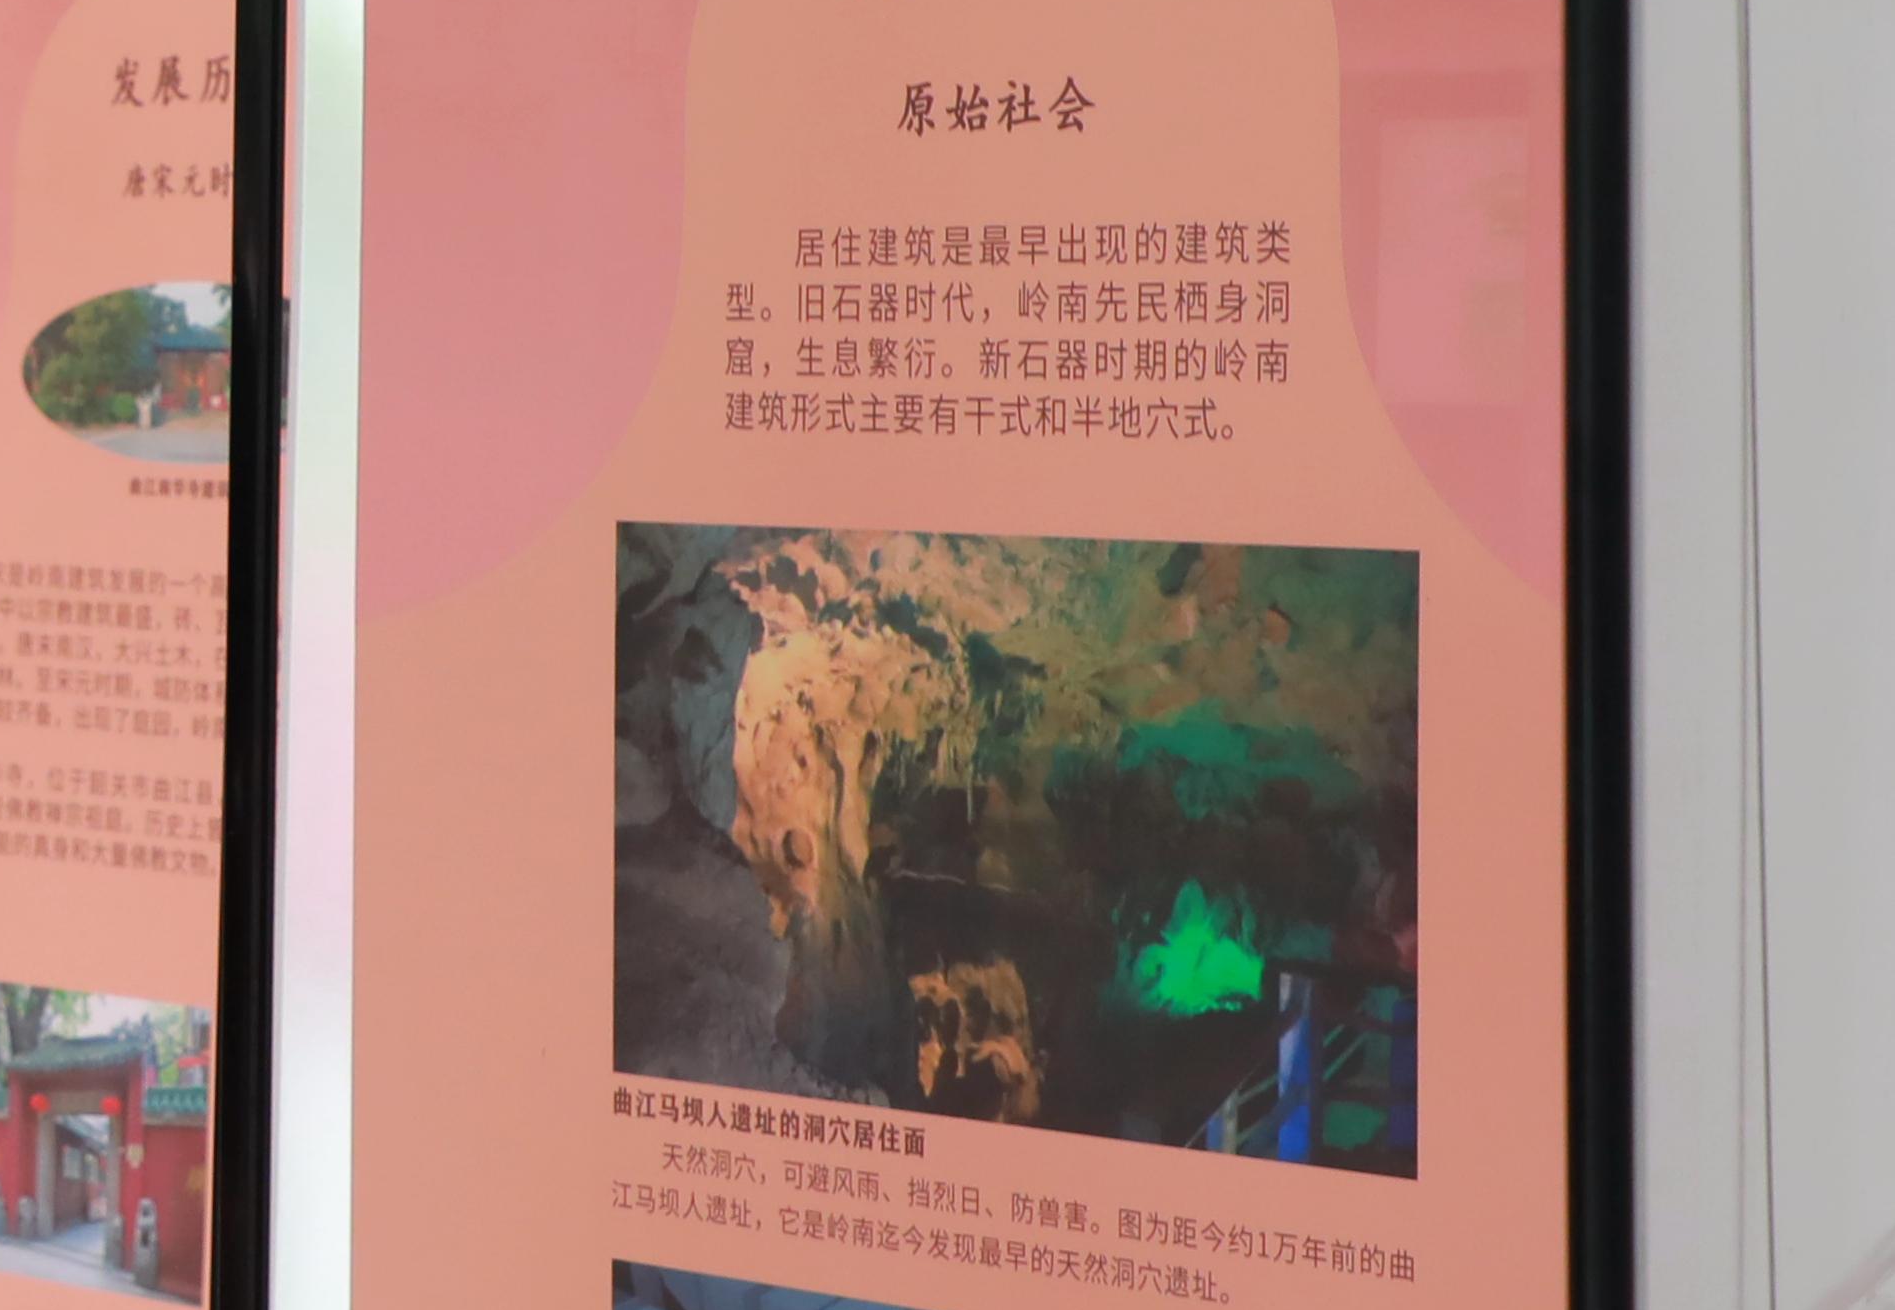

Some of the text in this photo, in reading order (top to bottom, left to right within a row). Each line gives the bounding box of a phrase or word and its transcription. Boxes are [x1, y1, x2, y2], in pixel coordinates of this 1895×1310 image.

[897, 76, 1096, 138] 原始社会
[795, 220, 1291, 269] 居住建筑是最早出现的建筑类
[612, 1087, 926, 1158] 曲江马坝人遗址的洞穴居住面
